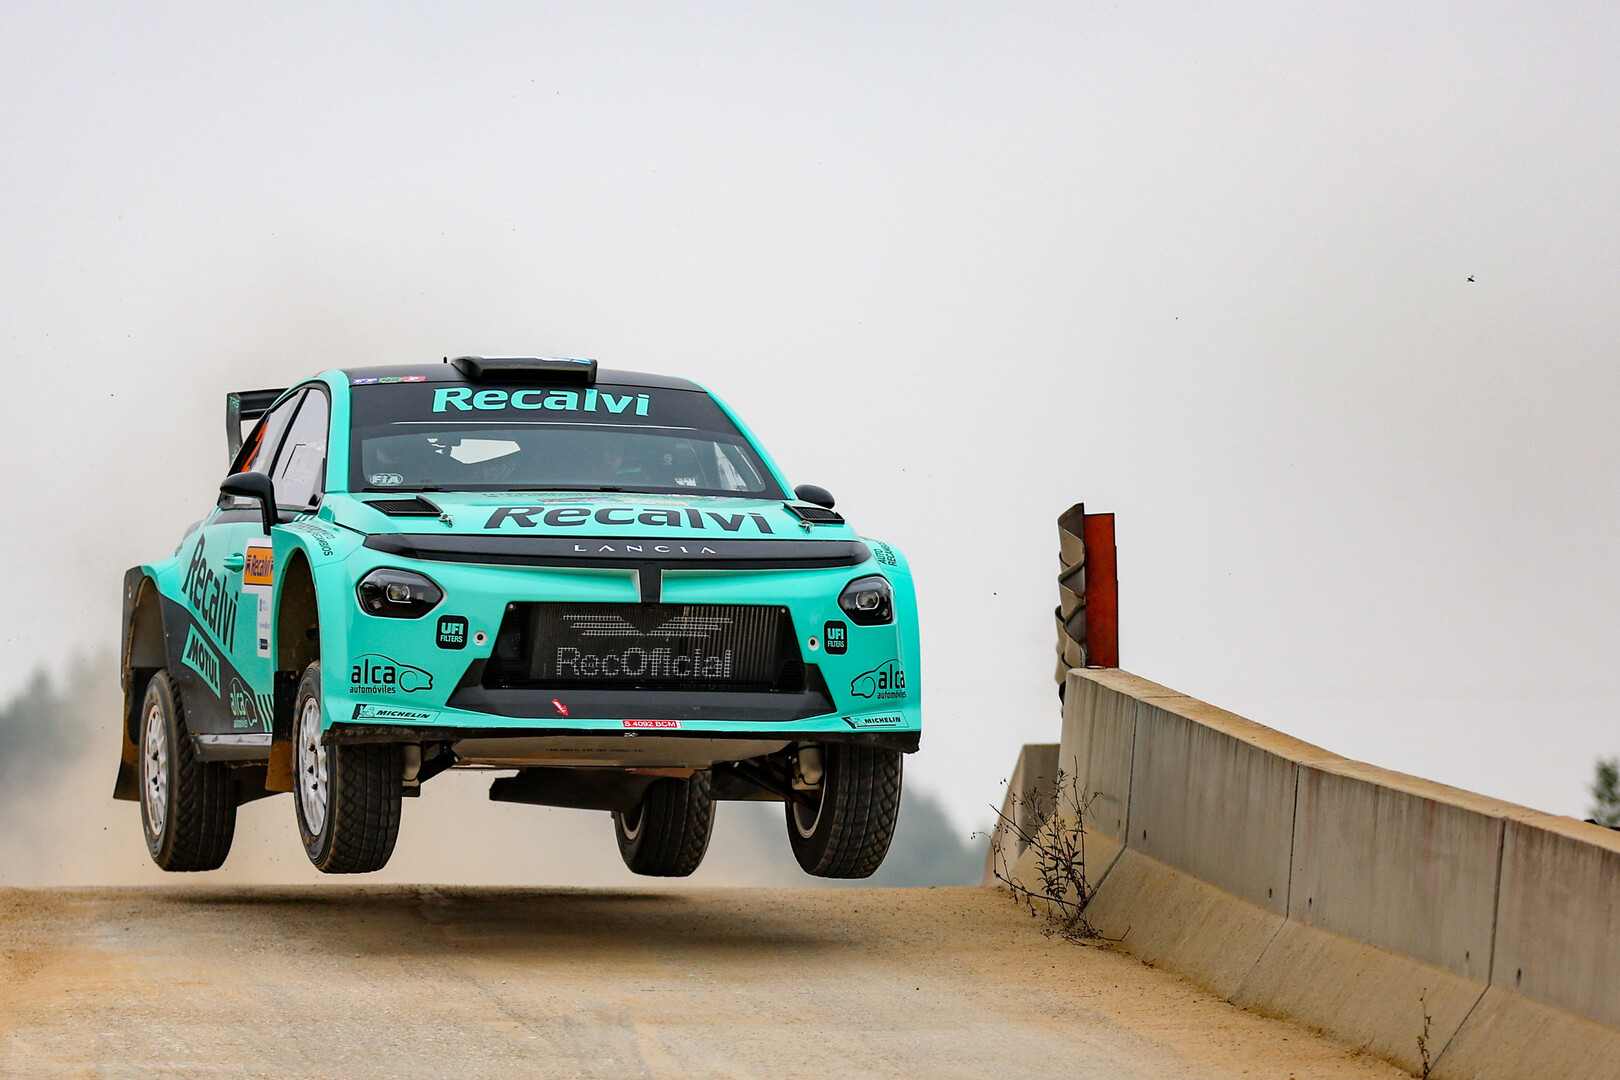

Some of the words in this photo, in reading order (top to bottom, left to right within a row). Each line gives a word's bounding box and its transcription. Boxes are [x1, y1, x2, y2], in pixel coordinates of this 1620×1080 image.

[432, 387, 650, 416] Recalvi
[371, 474, 400, 485] FIA
[484, 505, 775, 534] Recalvi
[574, 543, 717, 554] LANCIA
[181, 533, 239, 654] Recalvi
[441, 622, 464, 635] UFI
[827, 628, 844, 640] UFI
[440, 634, 464, 643] FILTERS
[827, 640, 845, 648] FILTERS
[187, 638, 219, 690] MOTUL
[556, 647, 732, 678] RecOficial
[351, 658, 396, 684] alca
[878, 664, 906, 689] alca
[349, 685, 396, 694] automóviles
[376, 709, 431, 719] MICHELIN
[864, 716, 901, 724] MICHELIN
